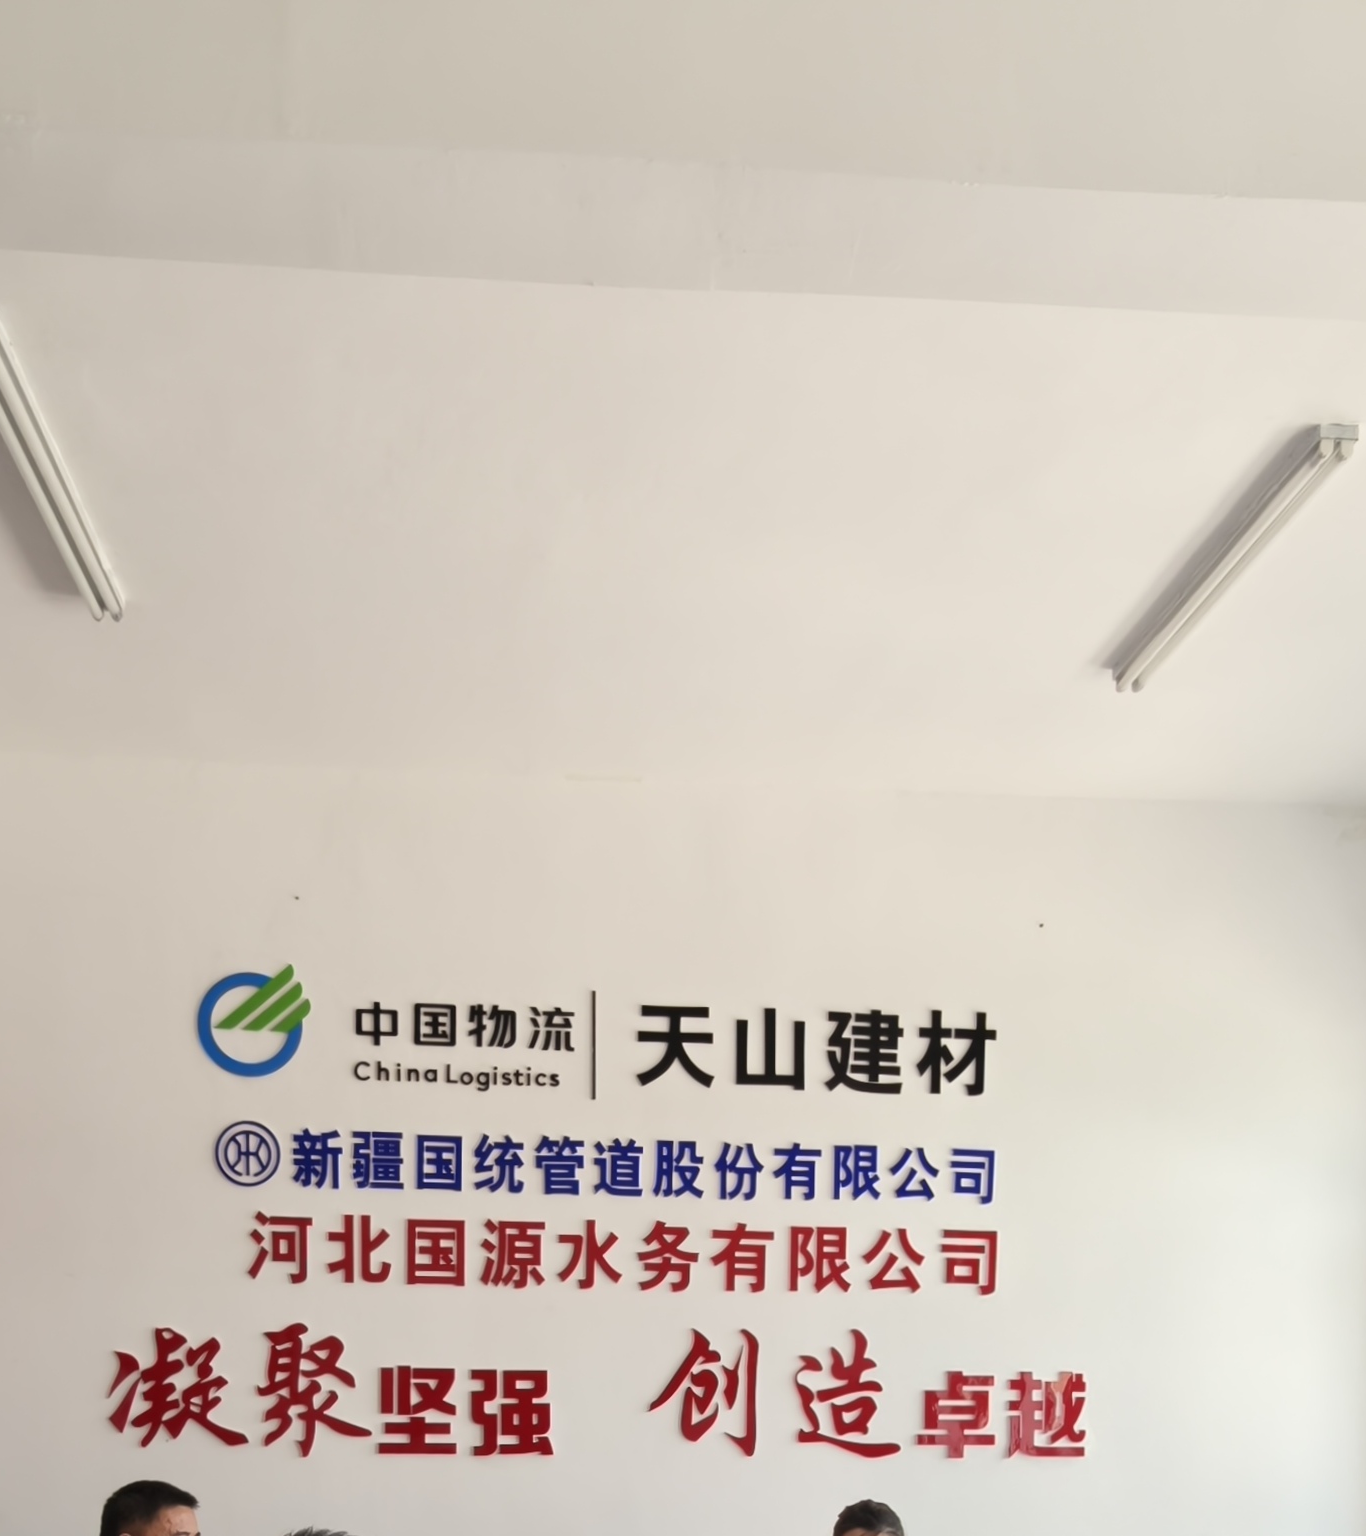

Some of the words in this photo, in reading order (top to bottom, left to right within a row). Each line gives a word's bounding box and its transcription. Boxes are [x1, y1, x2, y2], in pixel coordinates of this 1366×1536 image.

[353, 1061, 438, 1085] China
[444, 1064, 561, 1091] Logistics
[354, 1002, 576, 1052] 中国物流
[636, 1004, 998, 1096] 天山建材
[292, 1128, 996, 1206] 新疆国统管道股份有限公司
[247, 1210, 1000, 1295] 河北国源水务有限公司
[108, 1322, 554, 1457] 凝聚坚强
[648, 1328, 1087, 1459] 创造卓越
